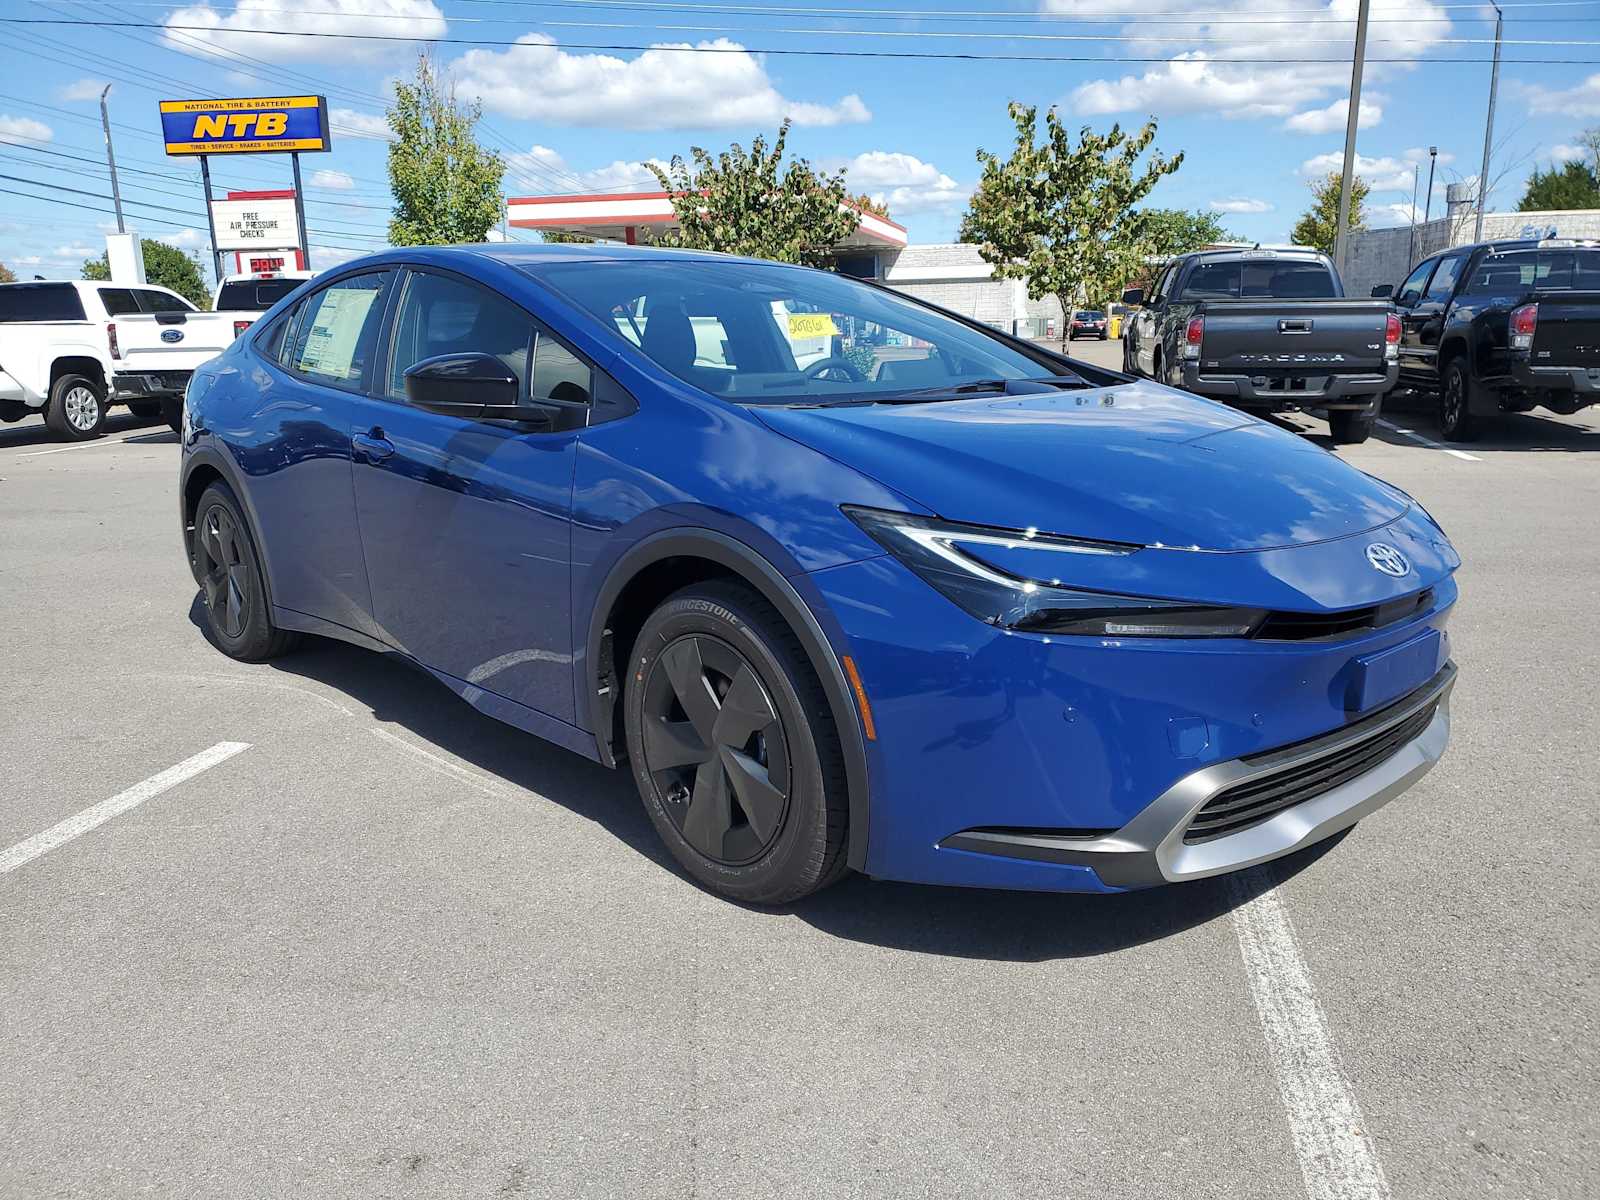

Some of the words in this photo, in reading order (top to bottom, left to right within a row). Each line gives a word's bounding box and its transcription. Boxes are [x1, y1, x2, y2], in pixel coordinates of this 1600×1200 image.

[192, 112, 289, 138] NTB
[242, 212, 259, 220] FREE
[230, 221, 242, 229] AIR
[245, 220, 278, 229] PRESSURE
[240, 229, 264, 238] CHECKS
[1240, 354, 1345, 362] TACOMA
[662, 599, 738, 625] IDGESTONE
